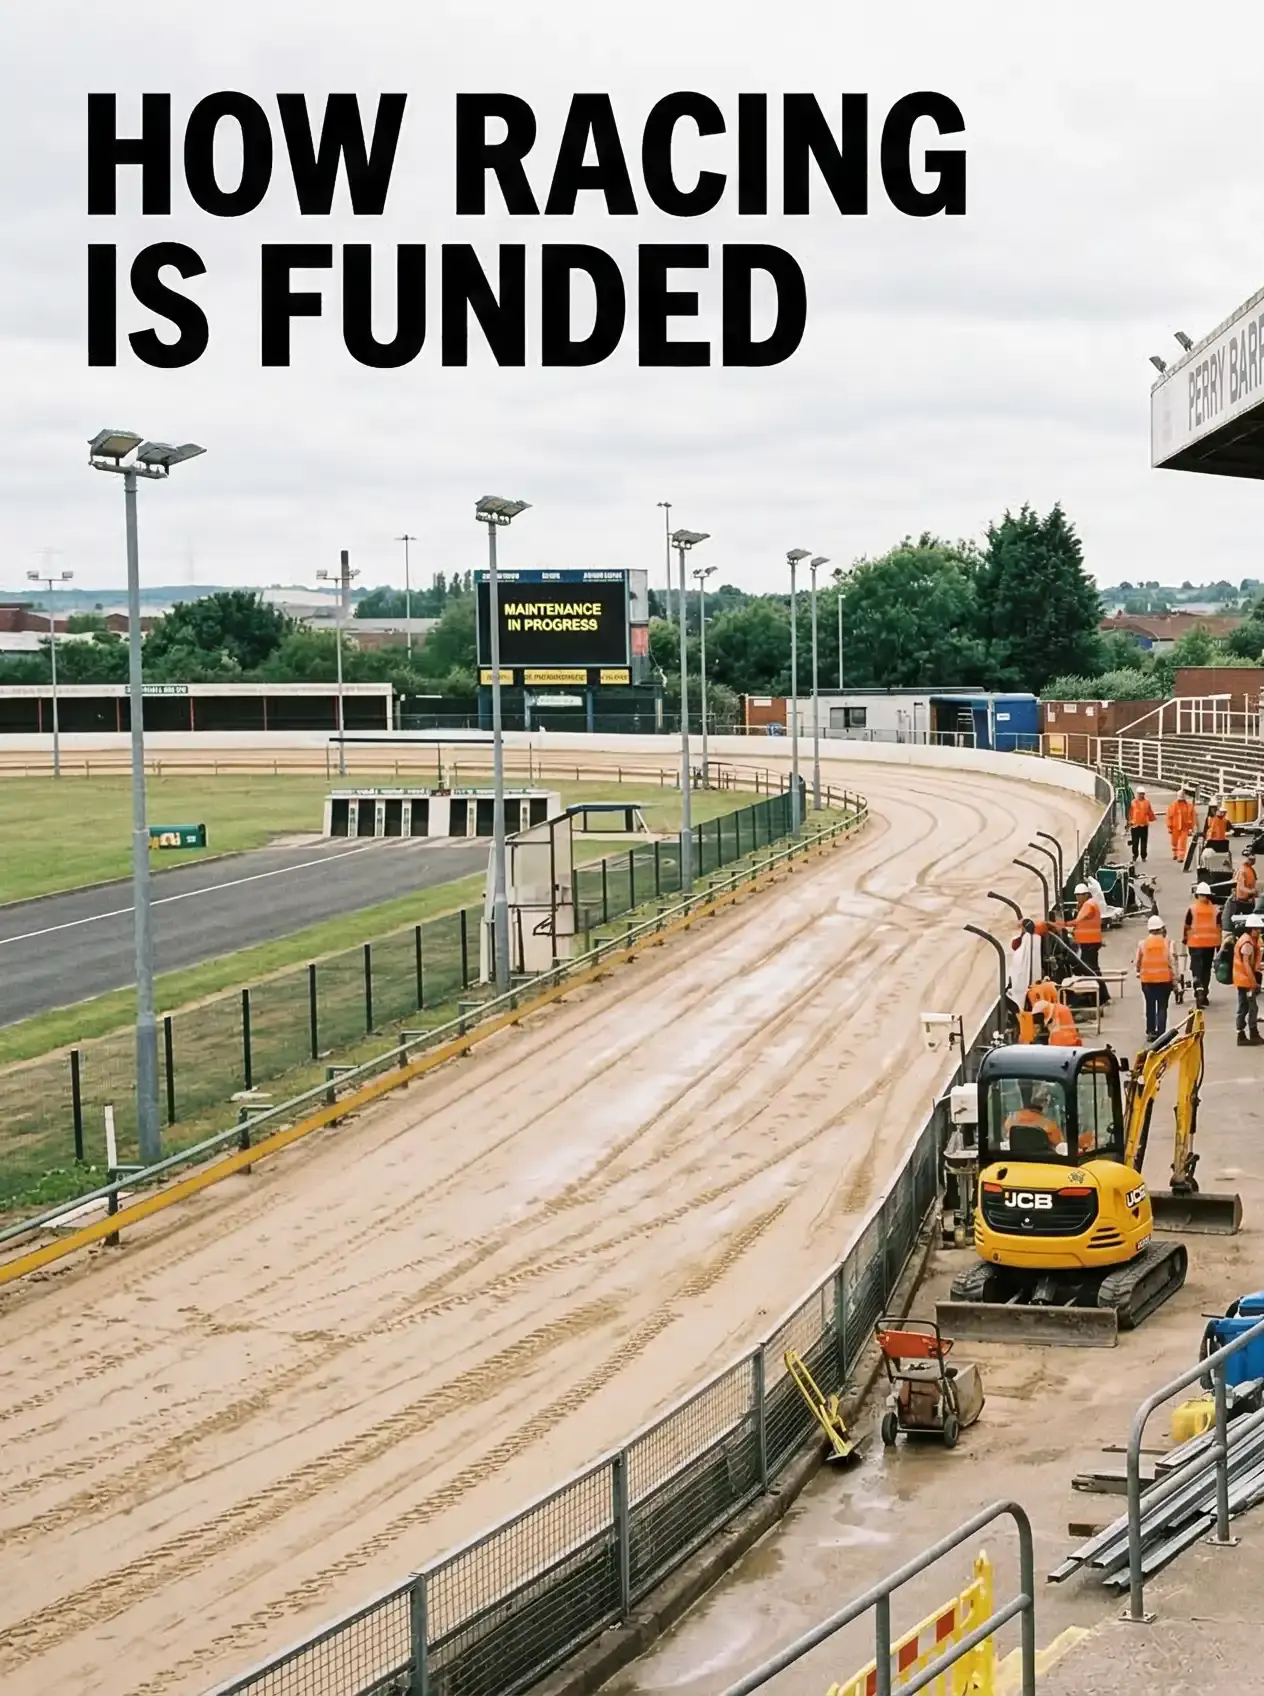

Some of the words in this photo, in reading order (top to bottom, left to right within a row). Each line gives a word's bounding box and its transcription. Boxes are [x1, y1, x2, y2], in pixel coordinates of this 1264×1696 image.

[1188, 345, 1226, 432] PERRY
[504, 603, 602, 616] MAINTENANCE
[508, 619, 521, 631] IN
[524, 619, 598, 631] PROGRESS
[1004, 1191, 1053, 1209] JCB
